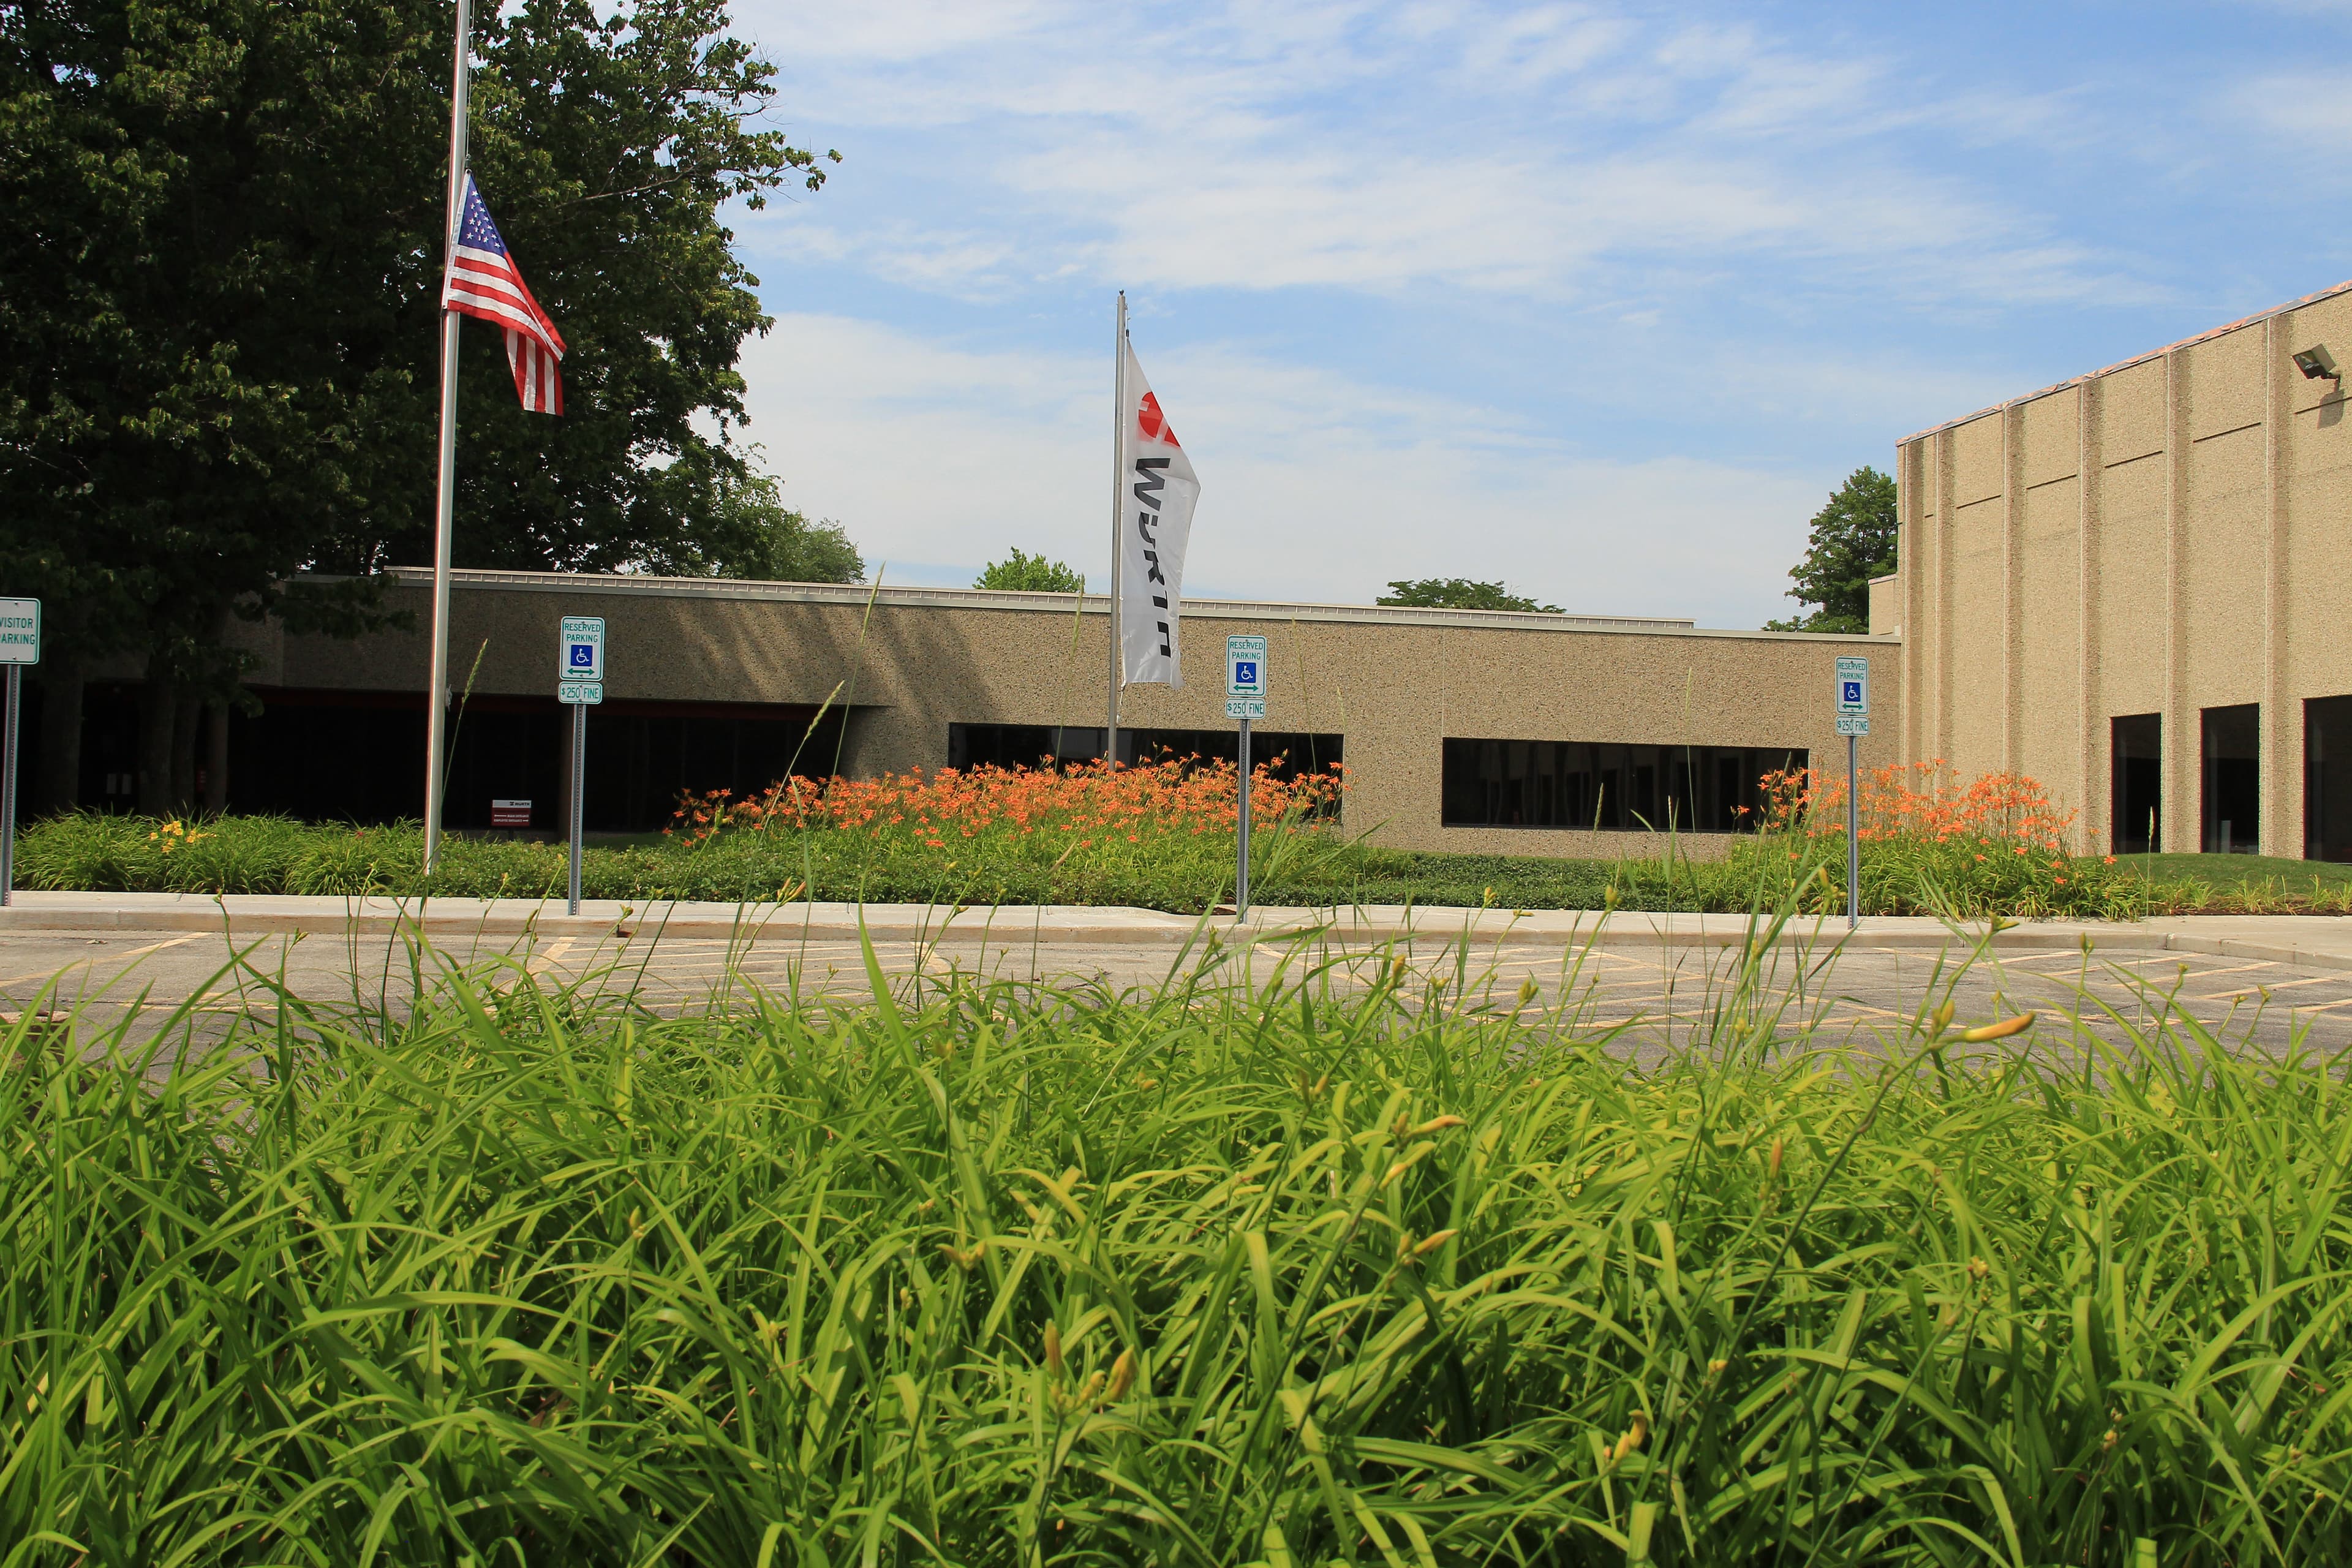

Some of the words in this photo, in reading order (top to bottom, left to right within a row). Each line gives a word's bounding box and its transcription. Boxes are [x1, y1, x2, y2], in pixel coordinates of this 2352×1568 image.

[0, 617, 33, 628] VISITOR
[564, 623, 600, 632] RESERVED
[0, 633, 35, 644] ARKING
[566, 634, 598, 643] PARKING
[1230, 641, 1263, 650] RESERVED
[1838, 662, 1865, 671] RESERVED
[584, 687, 598, 699] FINE
[1250, 703, 1264, 714] FINE
[1855, 721, 1868, 731] FINE
